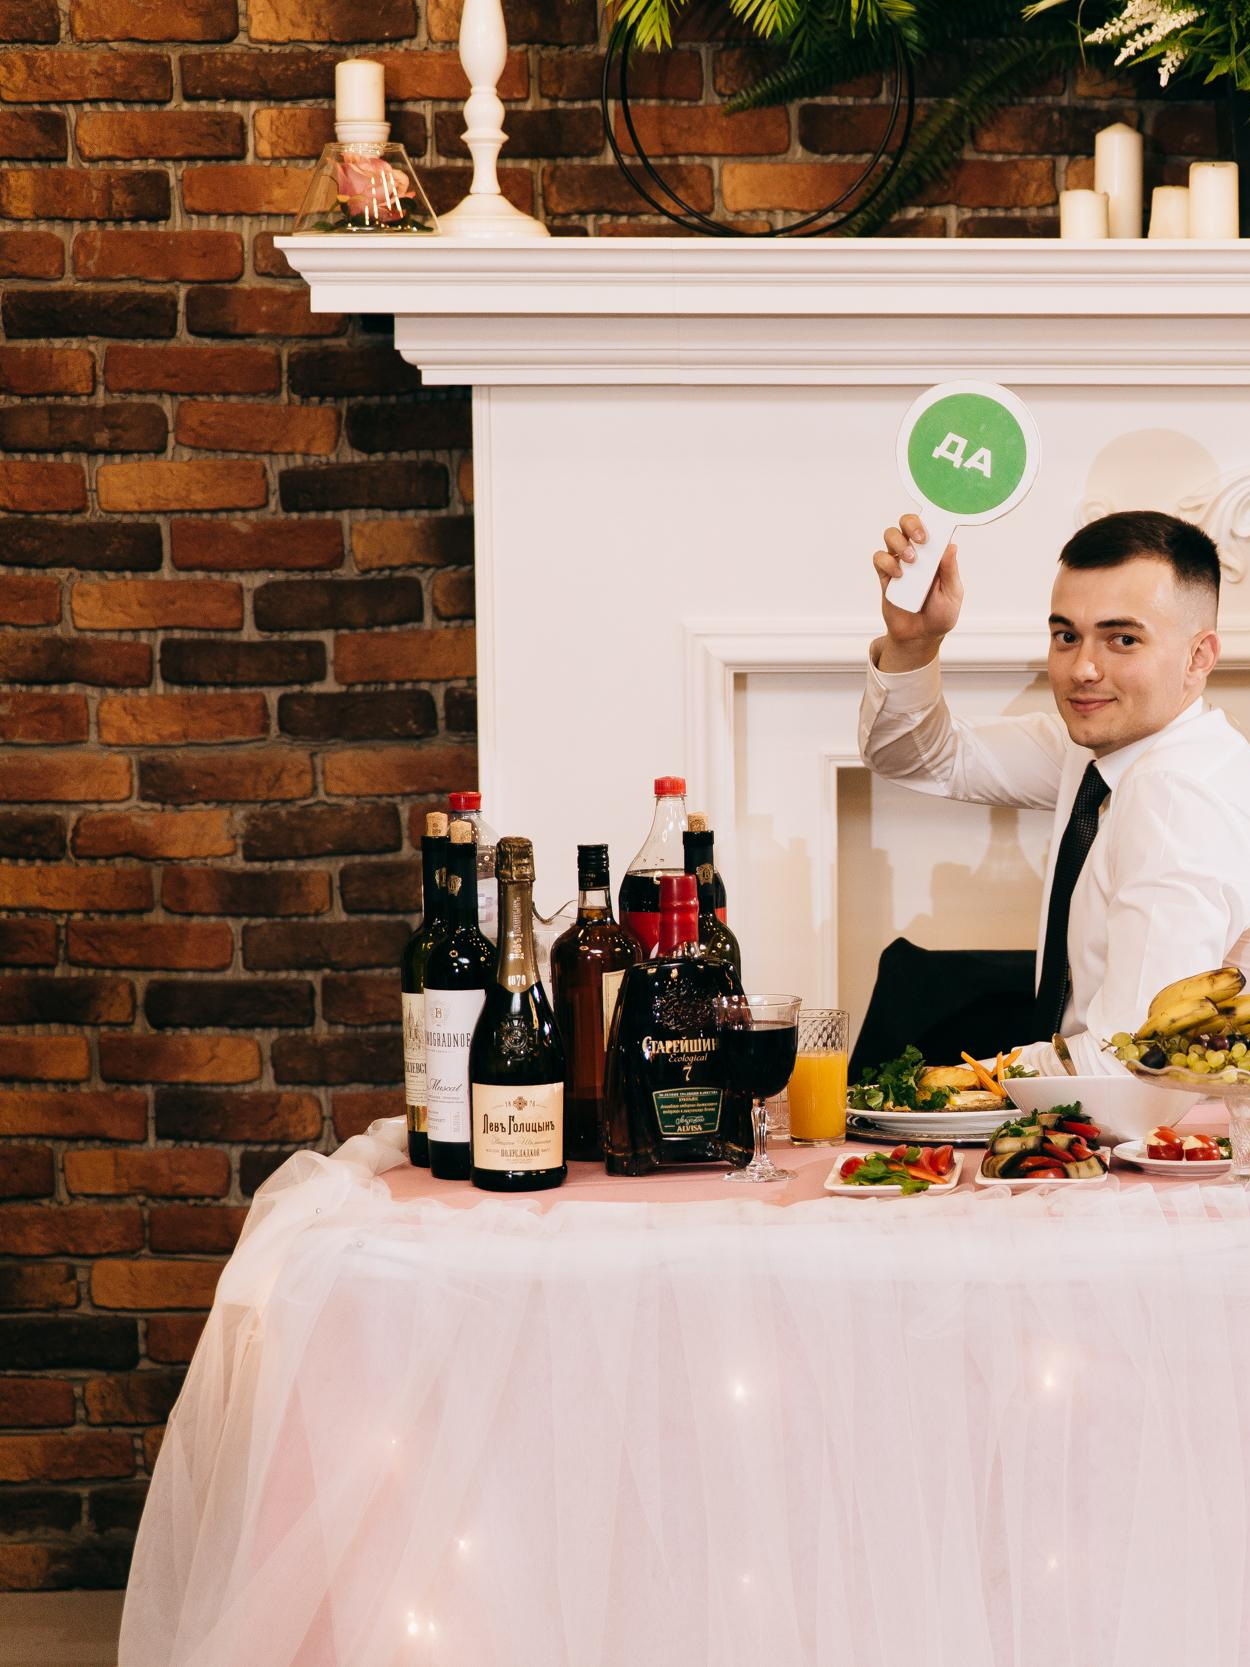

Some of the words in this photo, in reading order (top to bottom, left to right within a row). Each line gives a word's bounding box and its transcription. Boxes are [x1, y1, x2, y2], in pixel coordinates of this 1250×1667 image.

[932, 431, 993, 479] ДА
[668, 1052, 708, 1065] Ecological
[682, 1065, 693, 1081] 7
[482, 1113, 507, 1134] Левъ
[508, 1115, 555, 1135] Голицынъ
